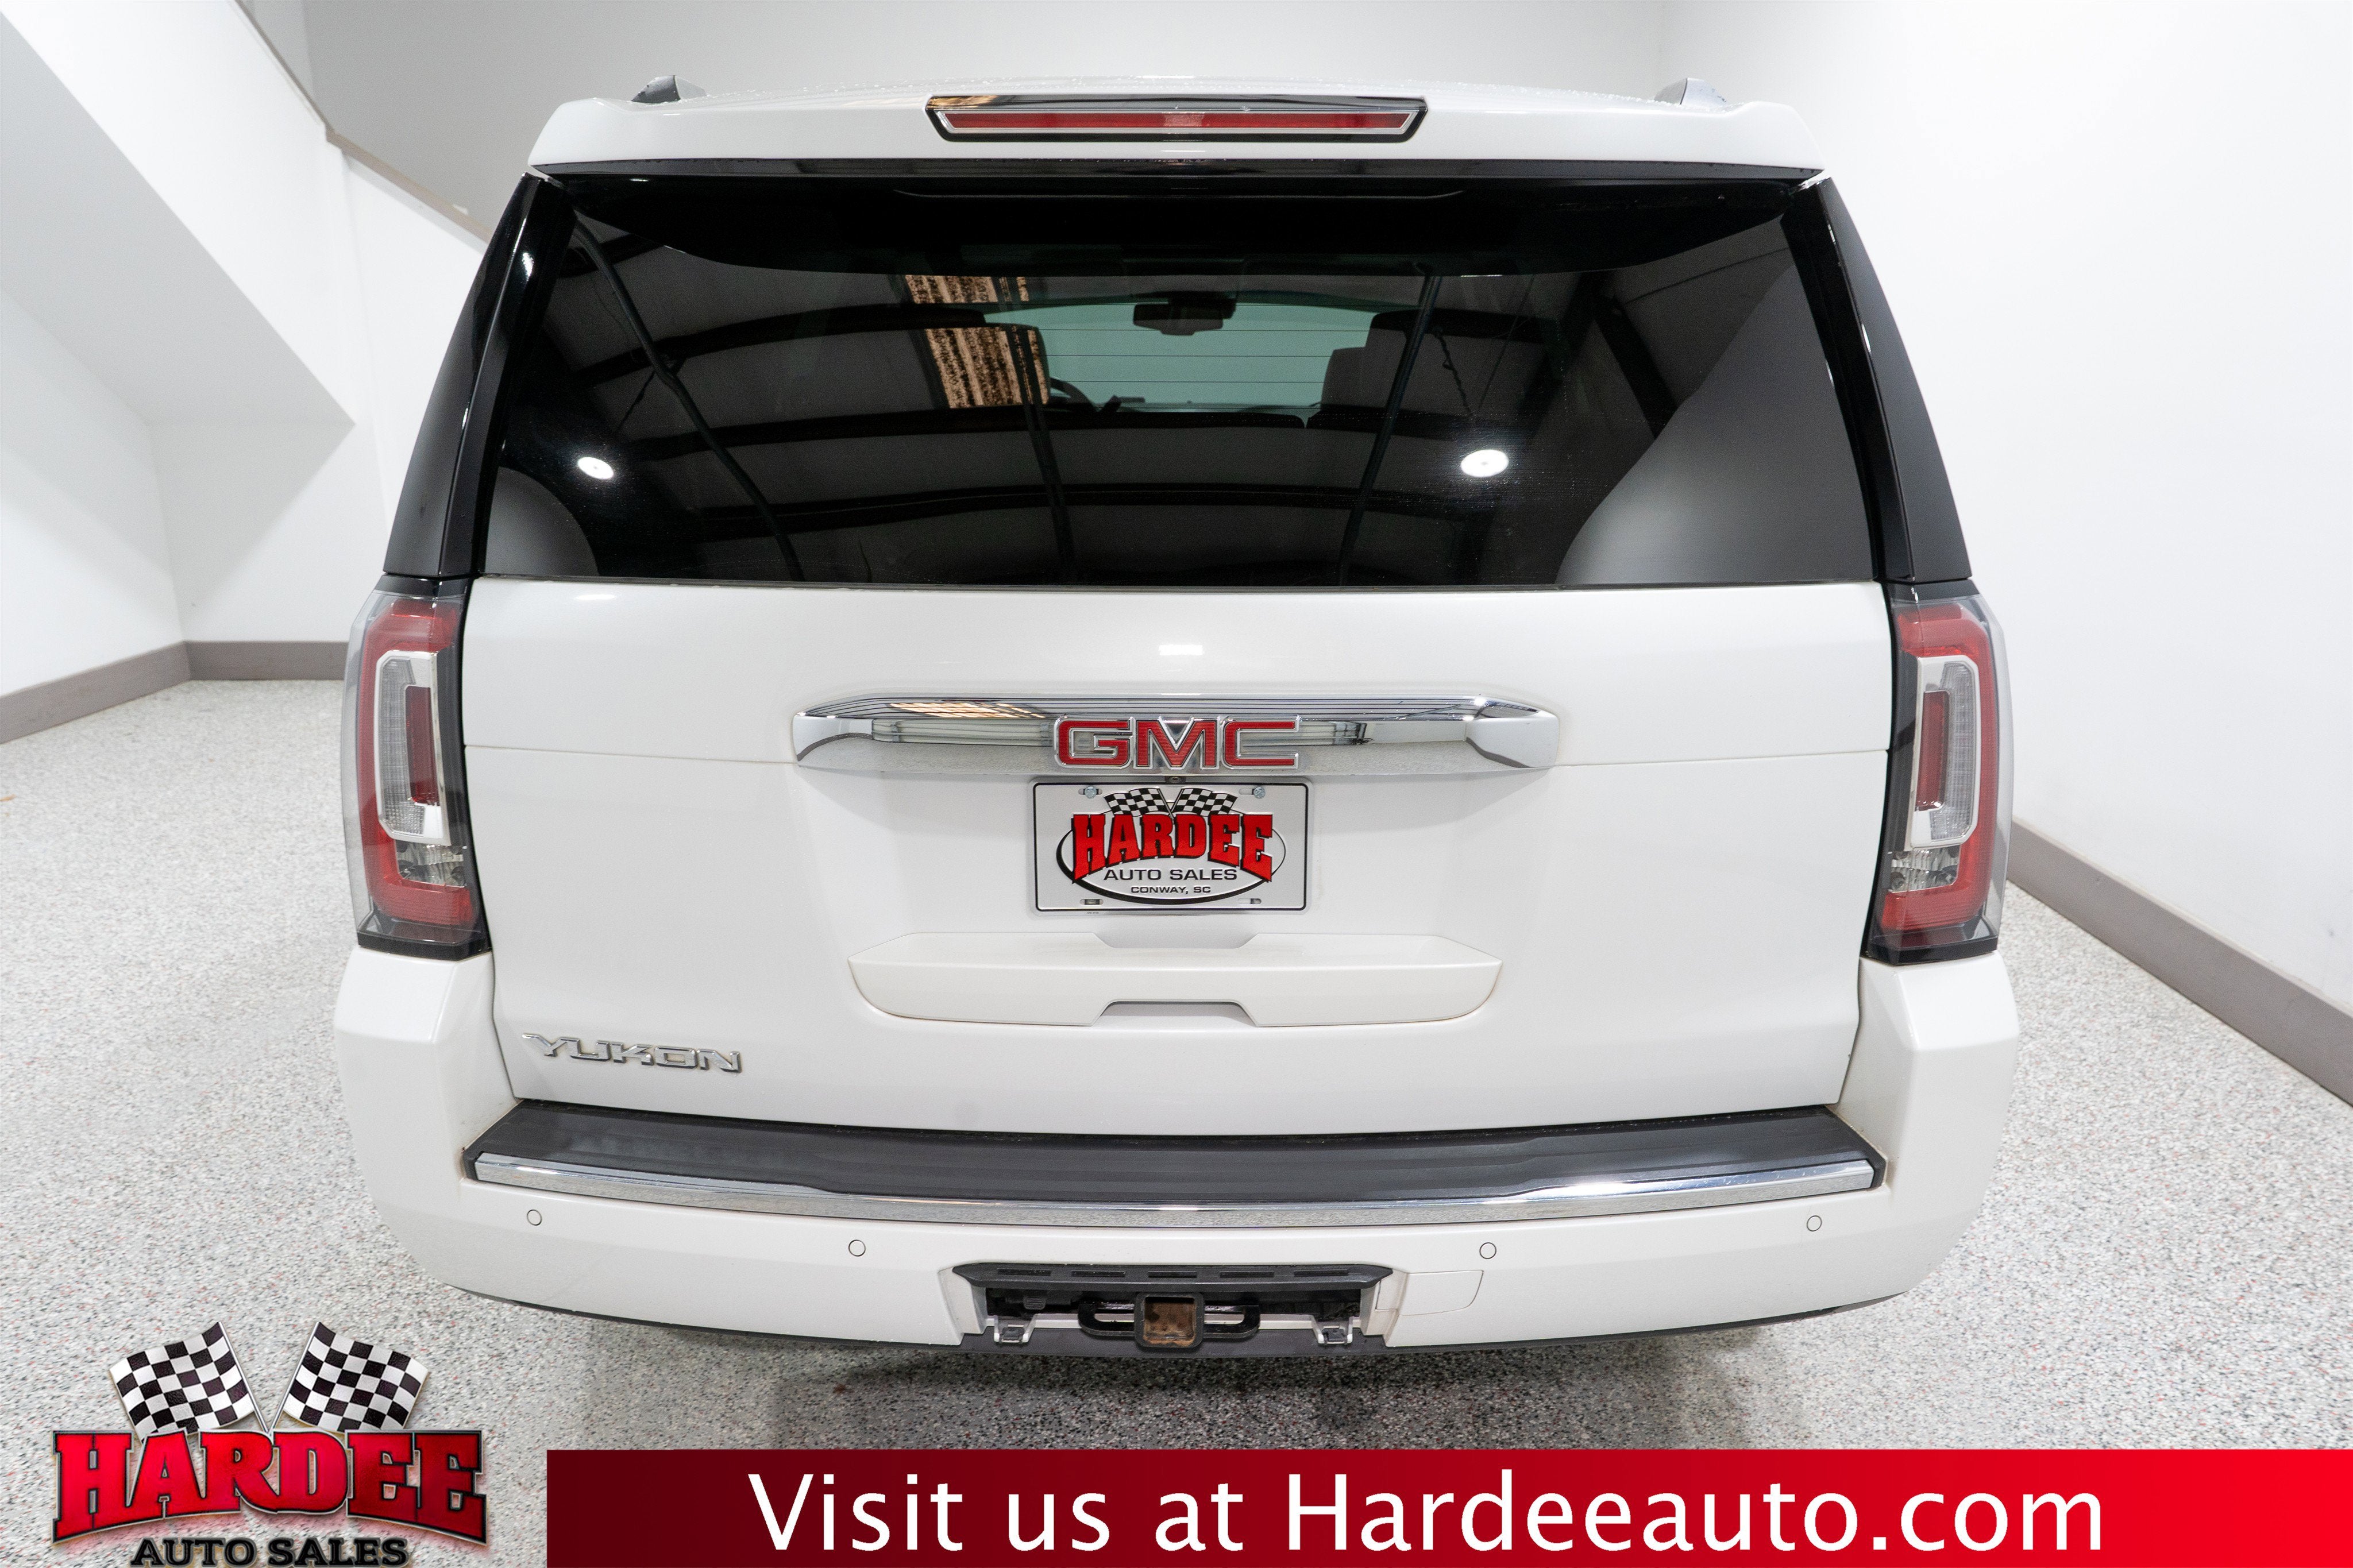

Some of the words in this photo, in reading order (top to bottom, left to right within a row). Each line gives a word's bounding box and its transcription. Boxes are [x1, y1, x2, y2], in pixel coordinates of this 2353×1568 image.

[1054, 716, 1302, 770] GMC
[1071, 814, 1273, 883] HARDEE
[1103, 868, 1162, 881] AUTO
[1170, 868, 1238, 881] SALES
[1131, 886, 1189, 895] CONWAY,
[522, 1033, 742, 1073] YUKON
